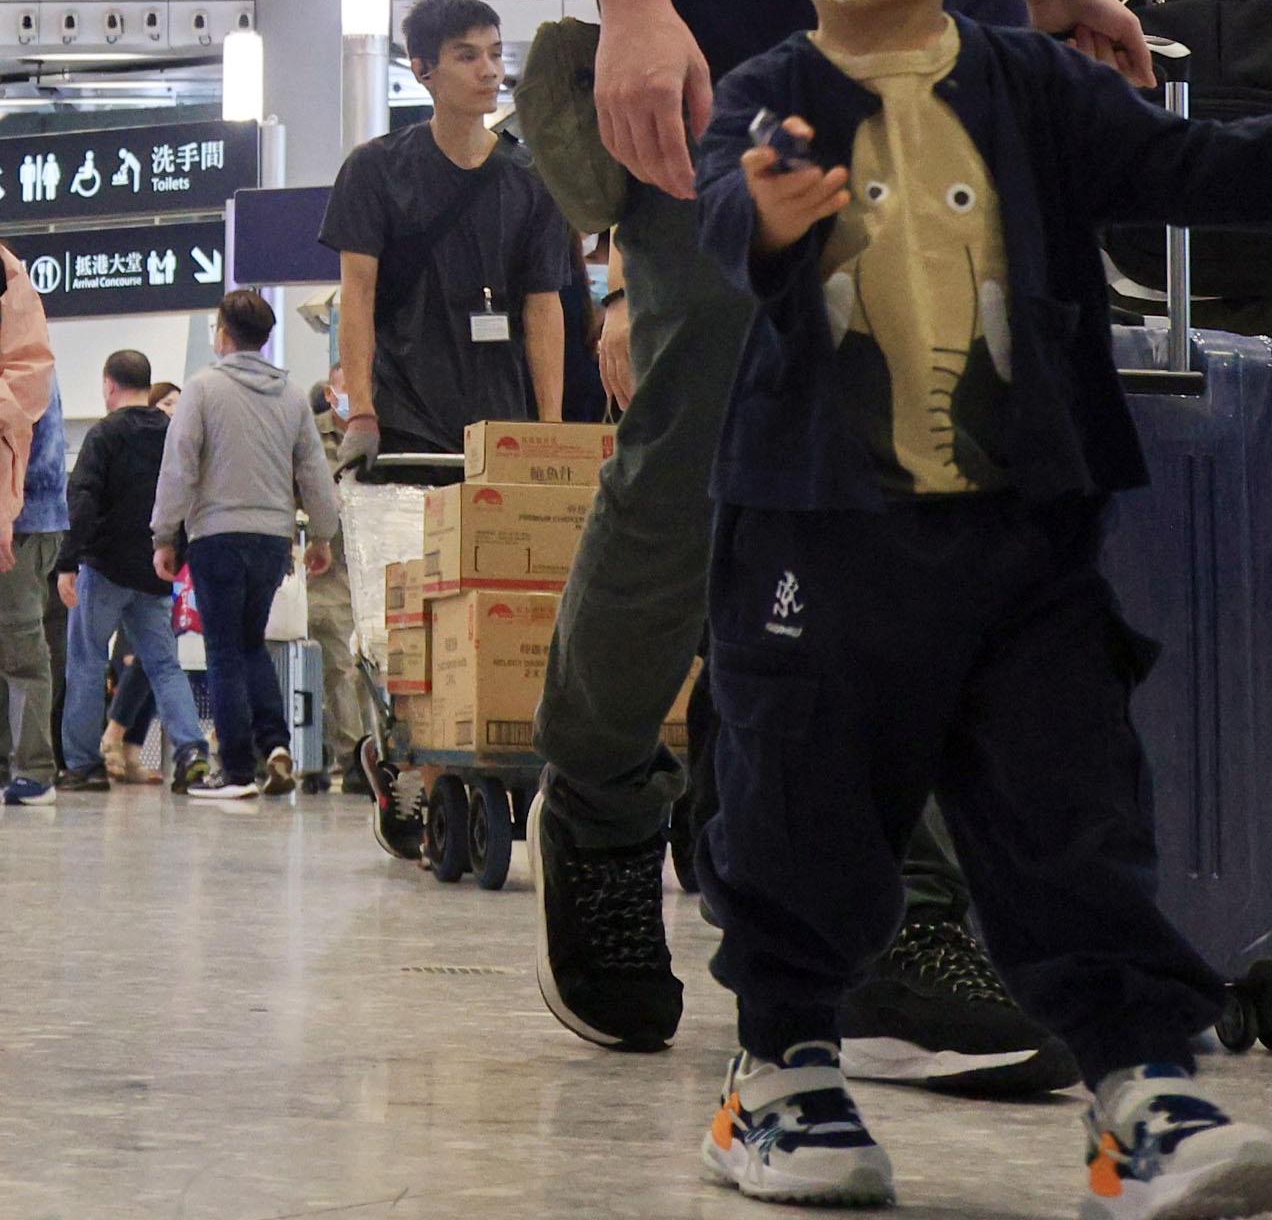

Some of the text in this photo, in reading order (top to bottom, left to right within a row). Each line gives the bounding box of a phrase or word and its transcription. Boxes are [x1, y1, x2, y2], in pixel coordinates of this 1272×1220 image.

[150, 140, 225, 174] 洗手間
[151, 175, 191, 193] Toilets
[75, 252, 143, 277] 抵港大堂
[72, 275, 143, 290] Arrival Concourse
